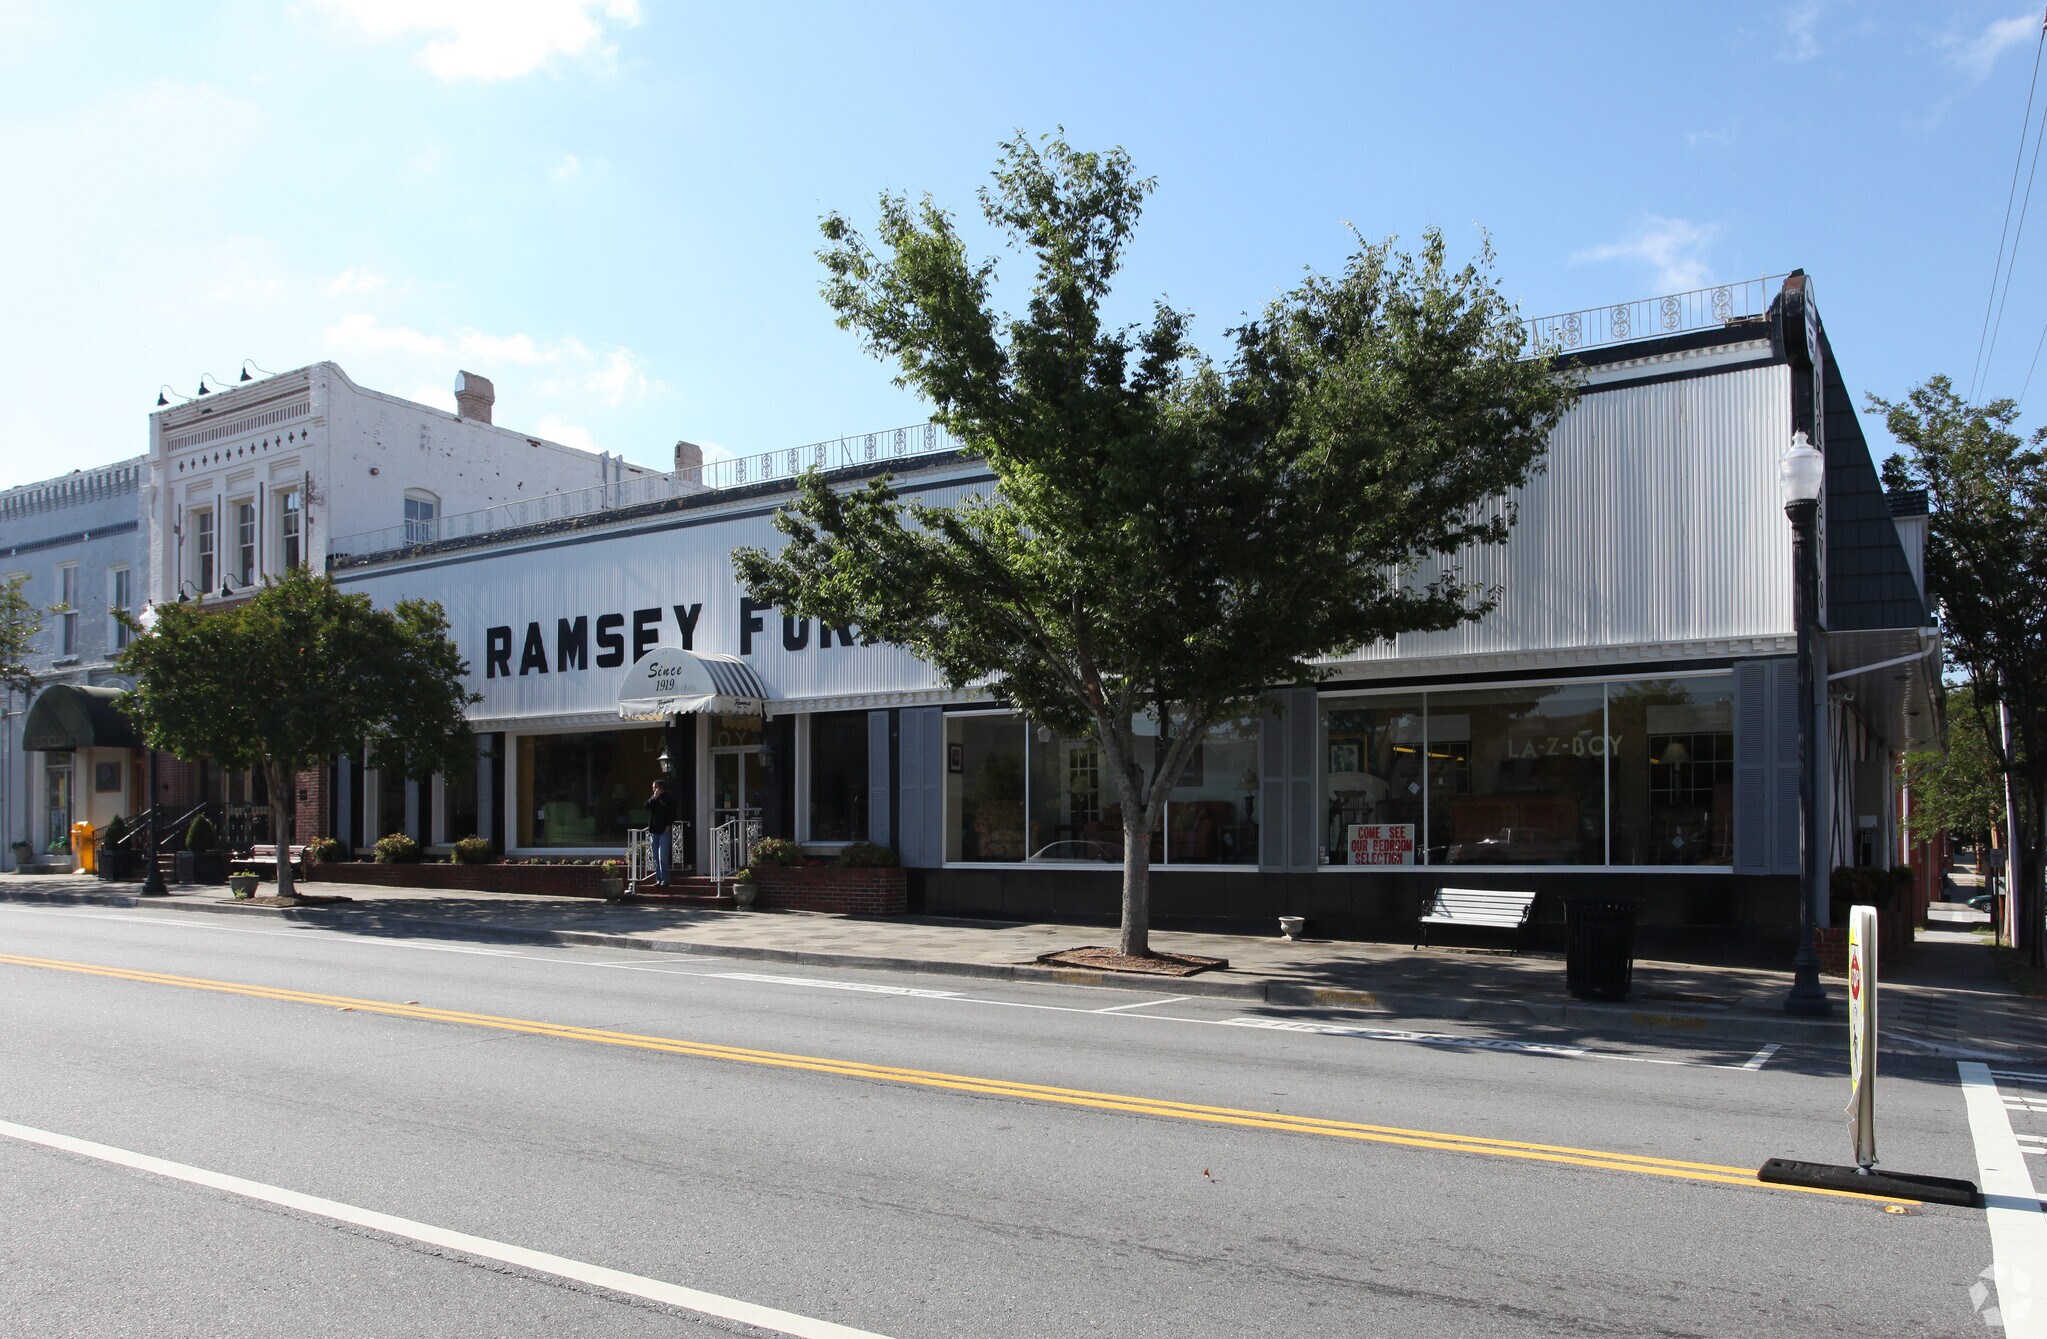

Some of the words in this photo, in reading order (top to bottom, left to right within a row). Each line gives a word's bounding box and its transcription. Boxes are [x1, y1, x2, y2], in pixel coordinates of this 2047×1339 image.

[487, 604, 702, 679] RAMSEY
[648, 662, 682, 678] Since
[655, 679, 675, 691] 1919
[1508, 735, 1624, 758] LA-Z-BOY
[1358, 827, 1380, 839] COME
[1389, 826, 1406, 838] SEE
[1351, 840, 1368, 852] OUR
[1373, 839, 1412, 852] BEDROOM
[1355, 852, 1403, 864] SELECTION
